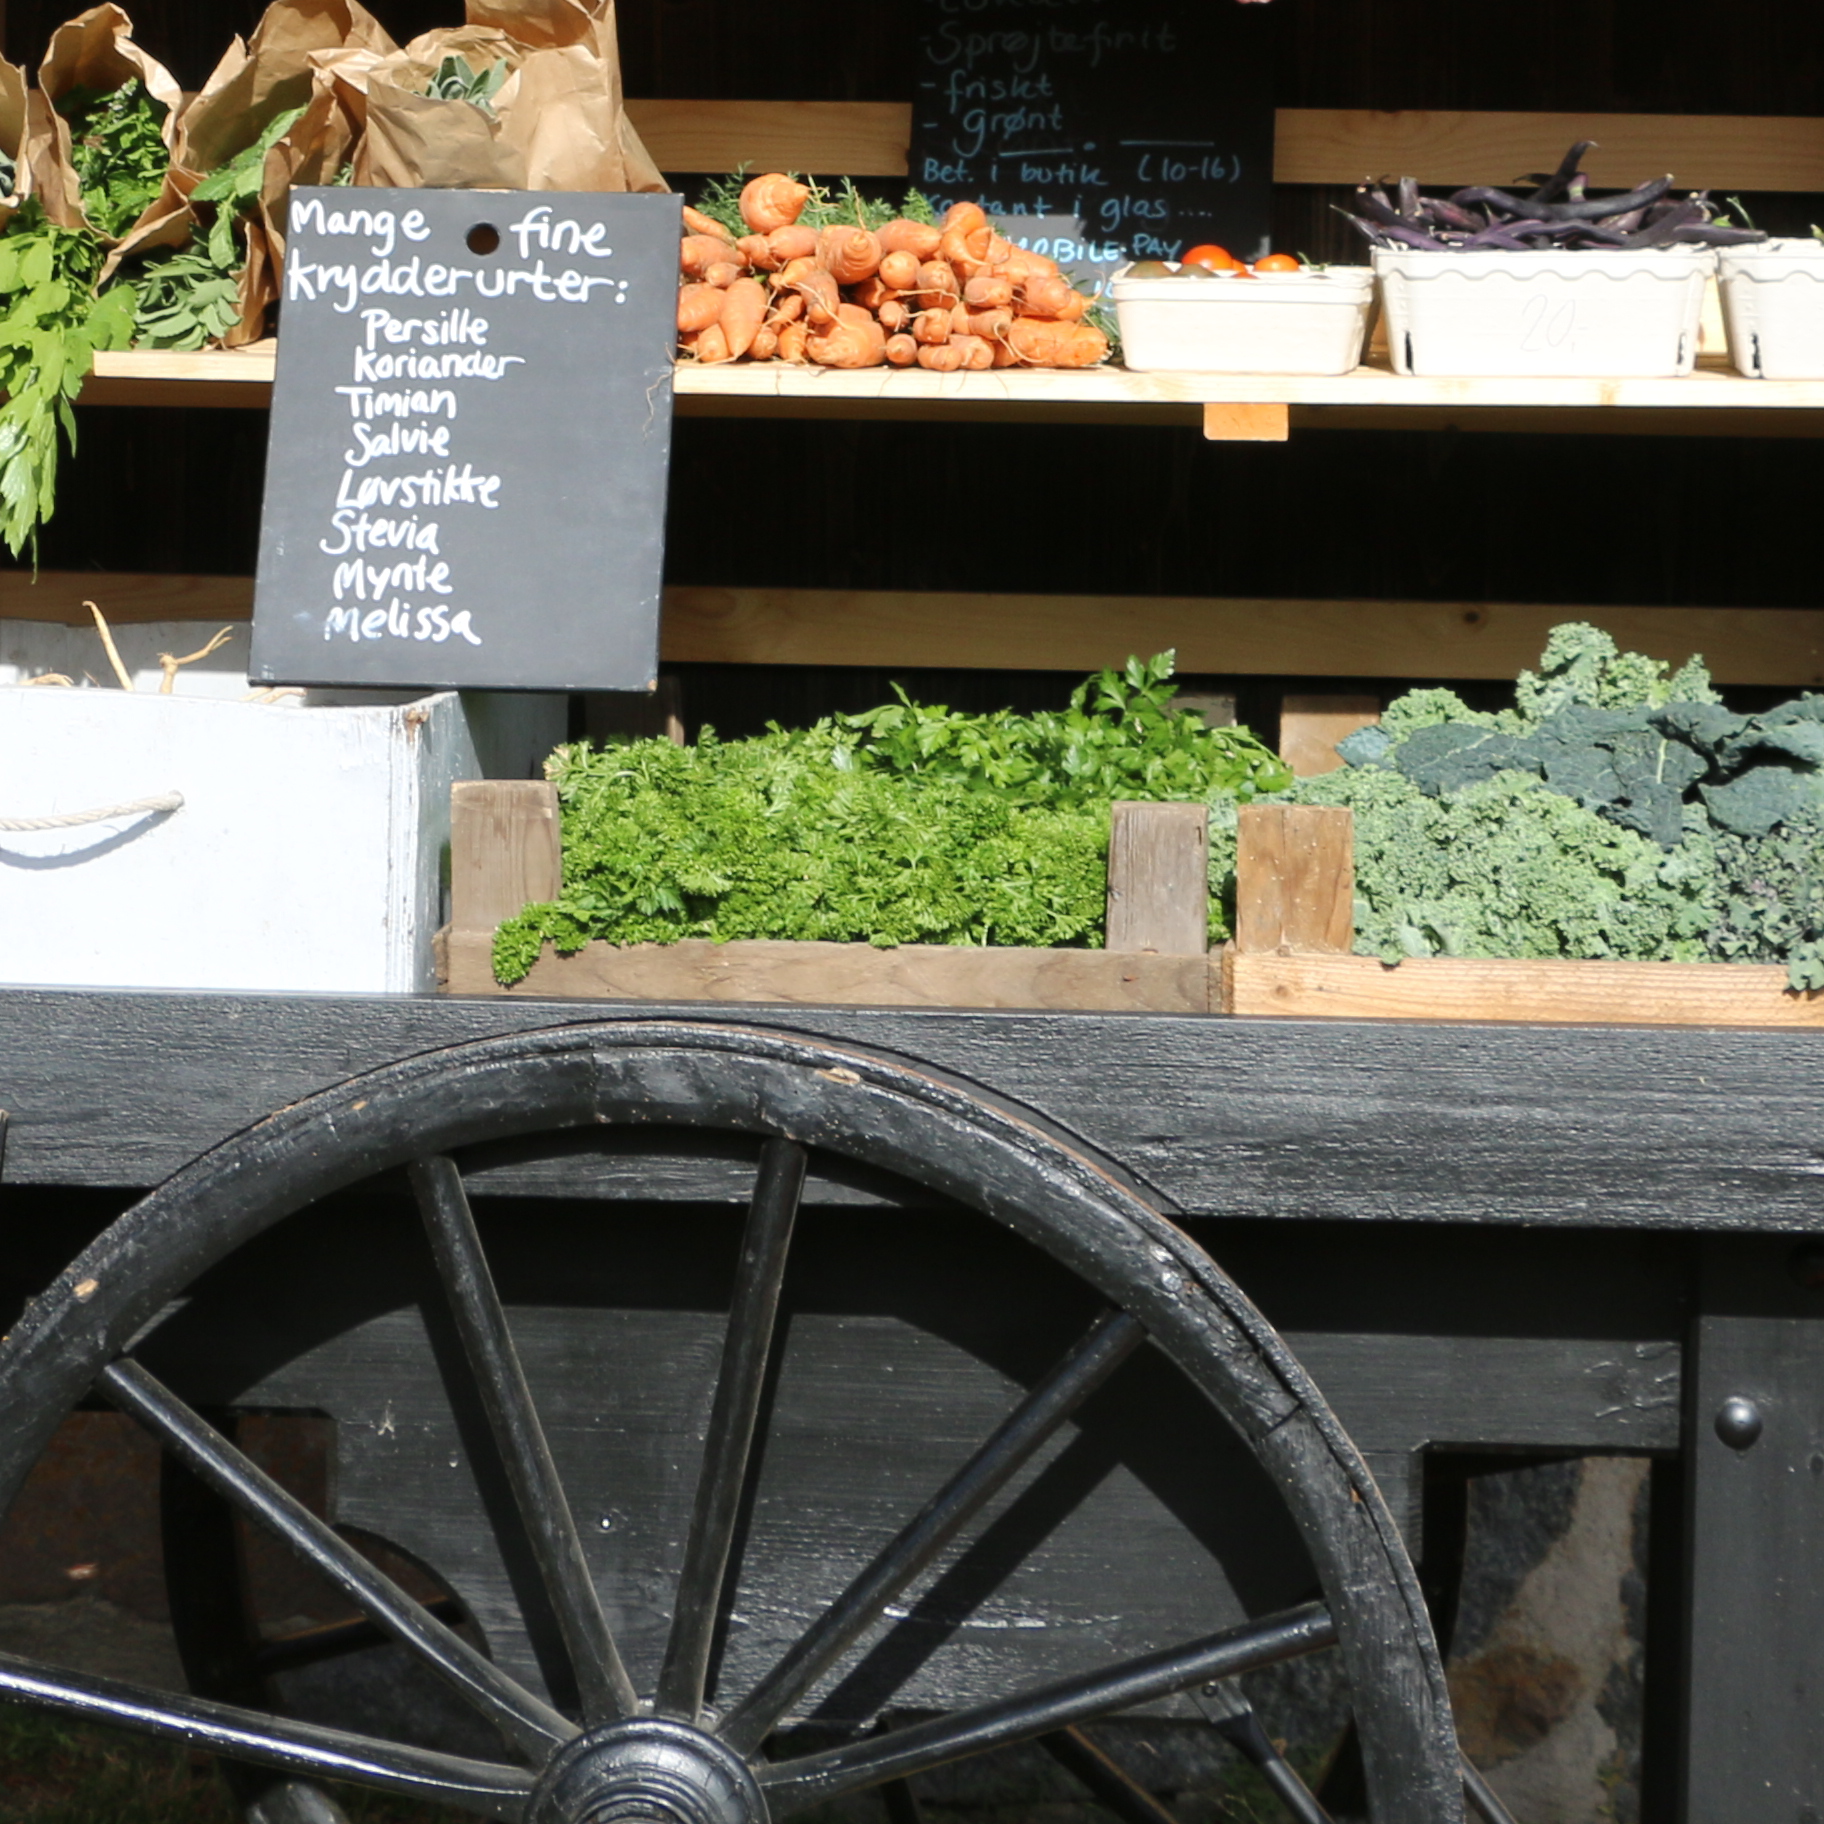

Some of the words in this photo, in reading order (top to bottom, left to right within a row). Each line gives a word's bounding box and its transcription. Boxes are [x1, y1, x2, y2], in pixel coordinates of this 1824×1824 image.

[951, 103, 1064, 159] grønt
[922, 156, 975, 183] Bet.
[989, 156, 999, 184] i
[1019, 159, 1110, 186] butik
[290, 198, 431, 258] Mange
[509, 205, 613, 259] fine
[1072, 198, 1082, 217] i
[360, 306, 489, 351] Persille
[353, 345, 526, 382] Koriander
[334, 385, 458, 420] Timian
[344, 420, 451, 467] Salvie
[335, 463, 501, 510] Løvstikke
[319, 508, 440, 556] Stevia
[333, 554, 453, 601] Mynte
